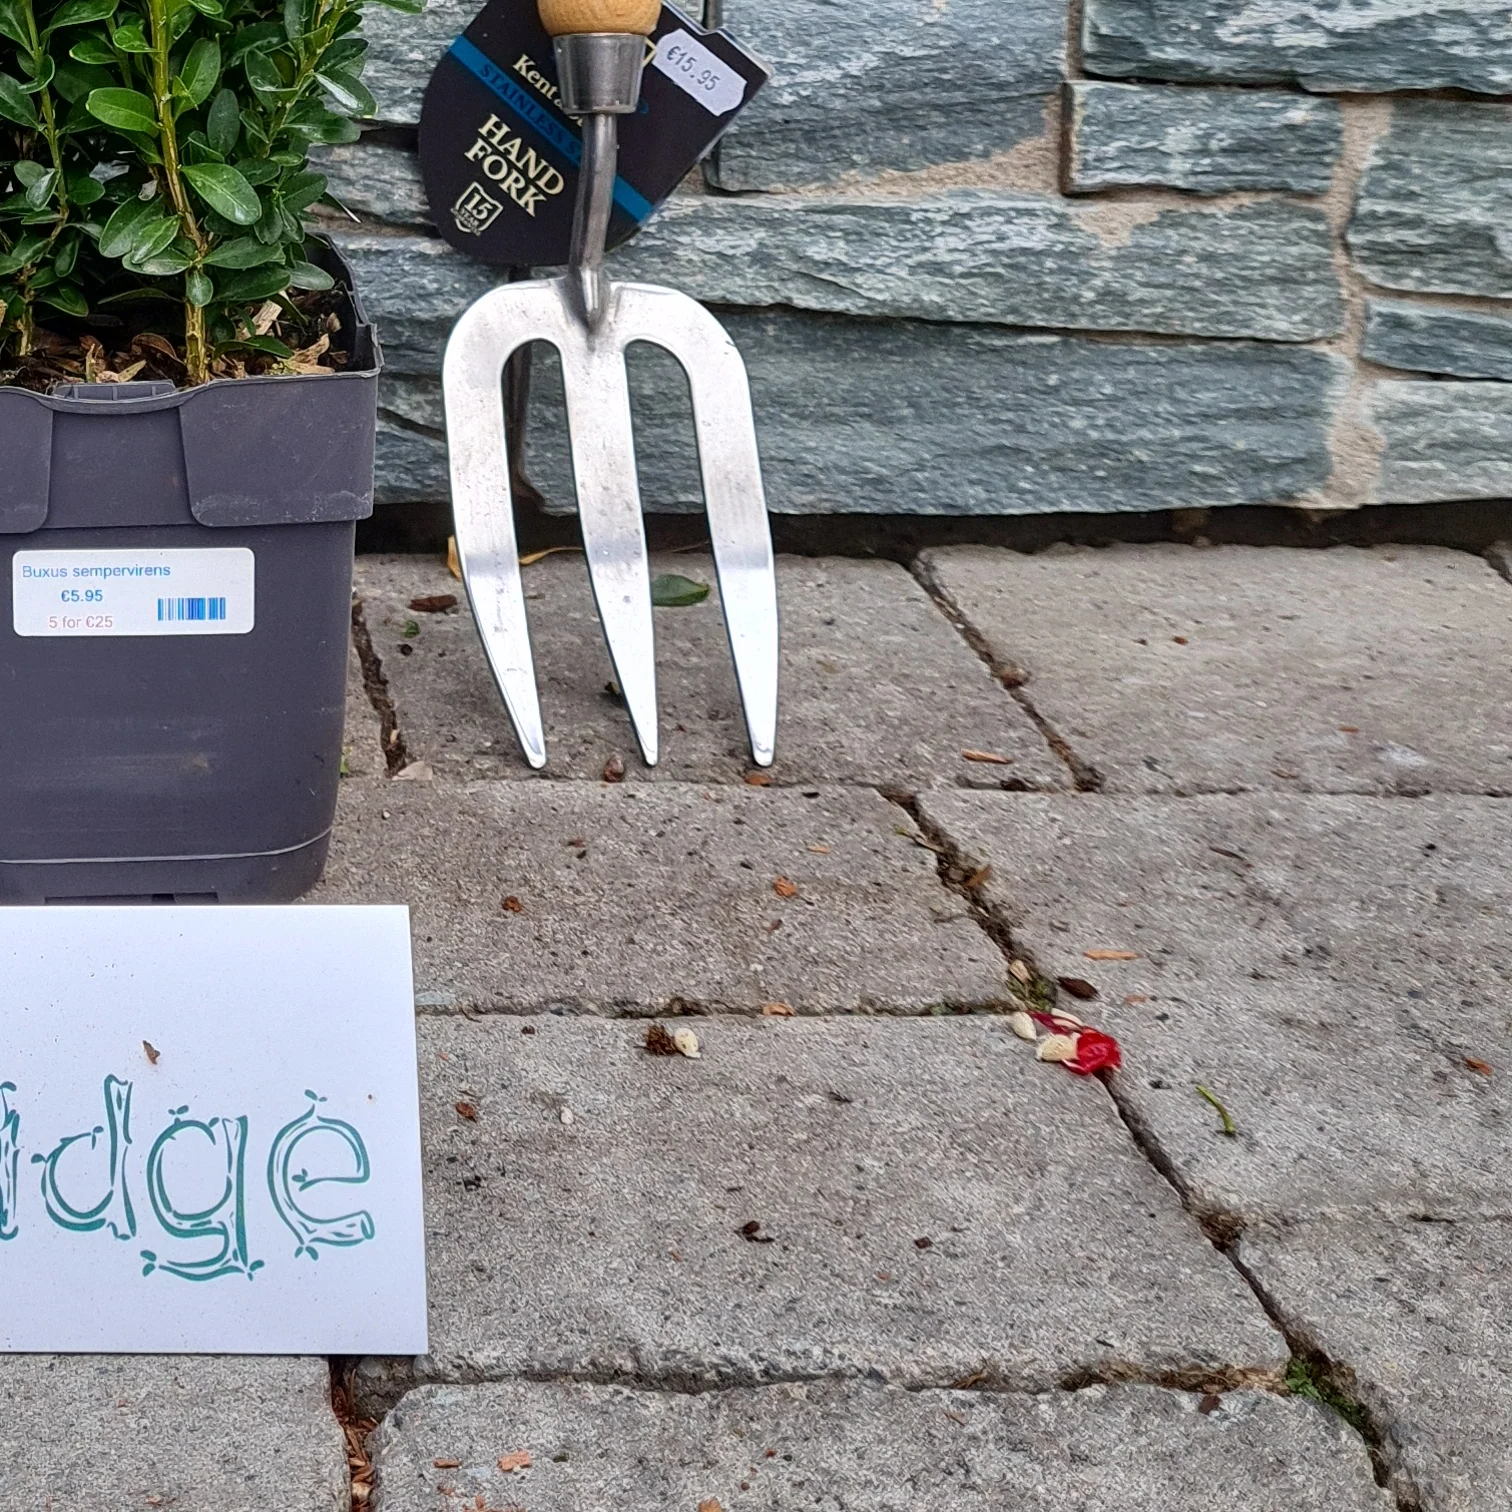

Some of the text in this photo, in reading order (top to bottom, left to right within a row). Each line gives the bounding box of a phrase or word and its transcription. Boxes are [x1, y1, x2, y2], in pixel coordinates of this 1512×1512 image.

[512, 53, 558, 100] Kent
[666, 45, 721, 91] €15.95
[480, 63, 568, 144] STAINLESS
[477, 113, 564, 195] HAND
[464, 138, 547, 217] FORK
[464, 192, 493, 220] 15
[22, 564, 171, 579] Buxus sempervirens
[61, 589, 103, 603] €5.95
[48, 615, 113, 629] 5 for €25
